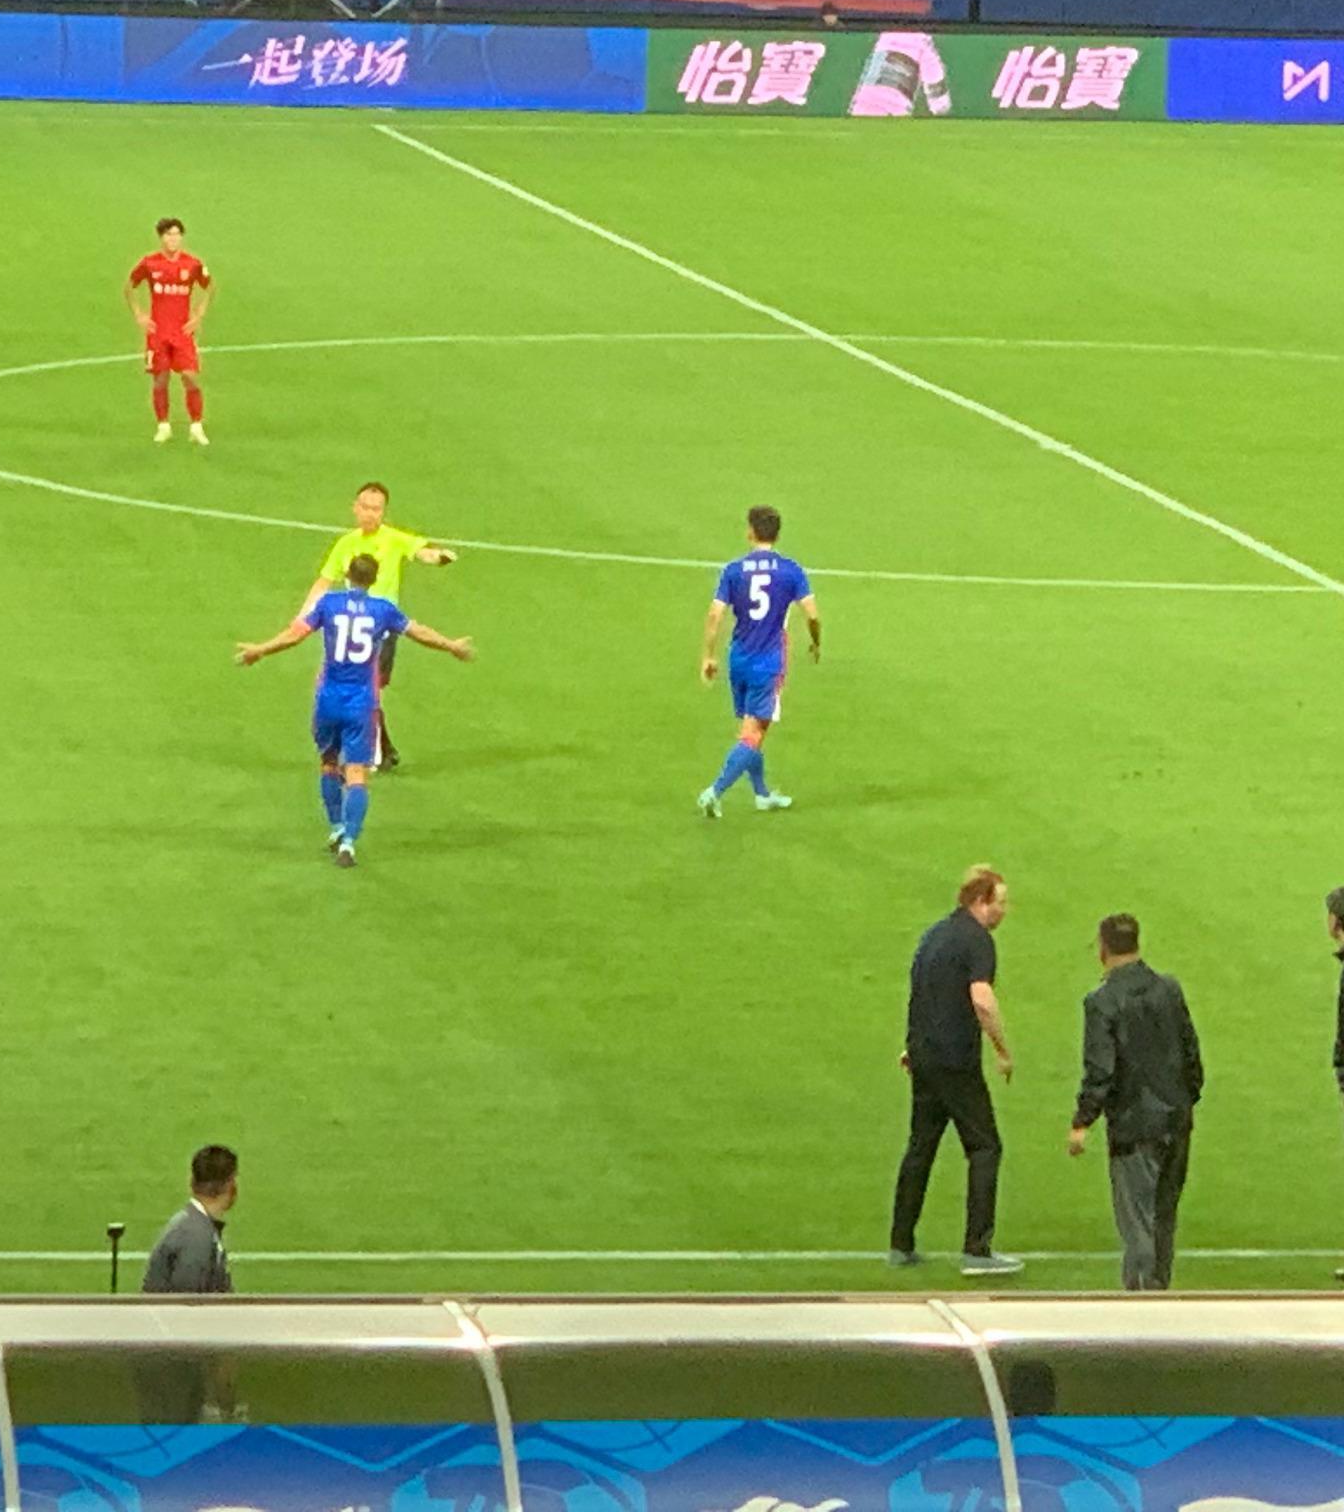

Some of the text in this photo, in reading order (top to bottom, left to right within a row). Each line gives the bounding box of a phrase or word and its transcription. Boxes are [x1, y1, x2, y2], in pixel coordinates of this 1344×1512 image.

[677, 39, 1139, 110] 怡寶 怡寶
[748, 574, 772, 621] 5
[333, 614, 376, 664] 15
